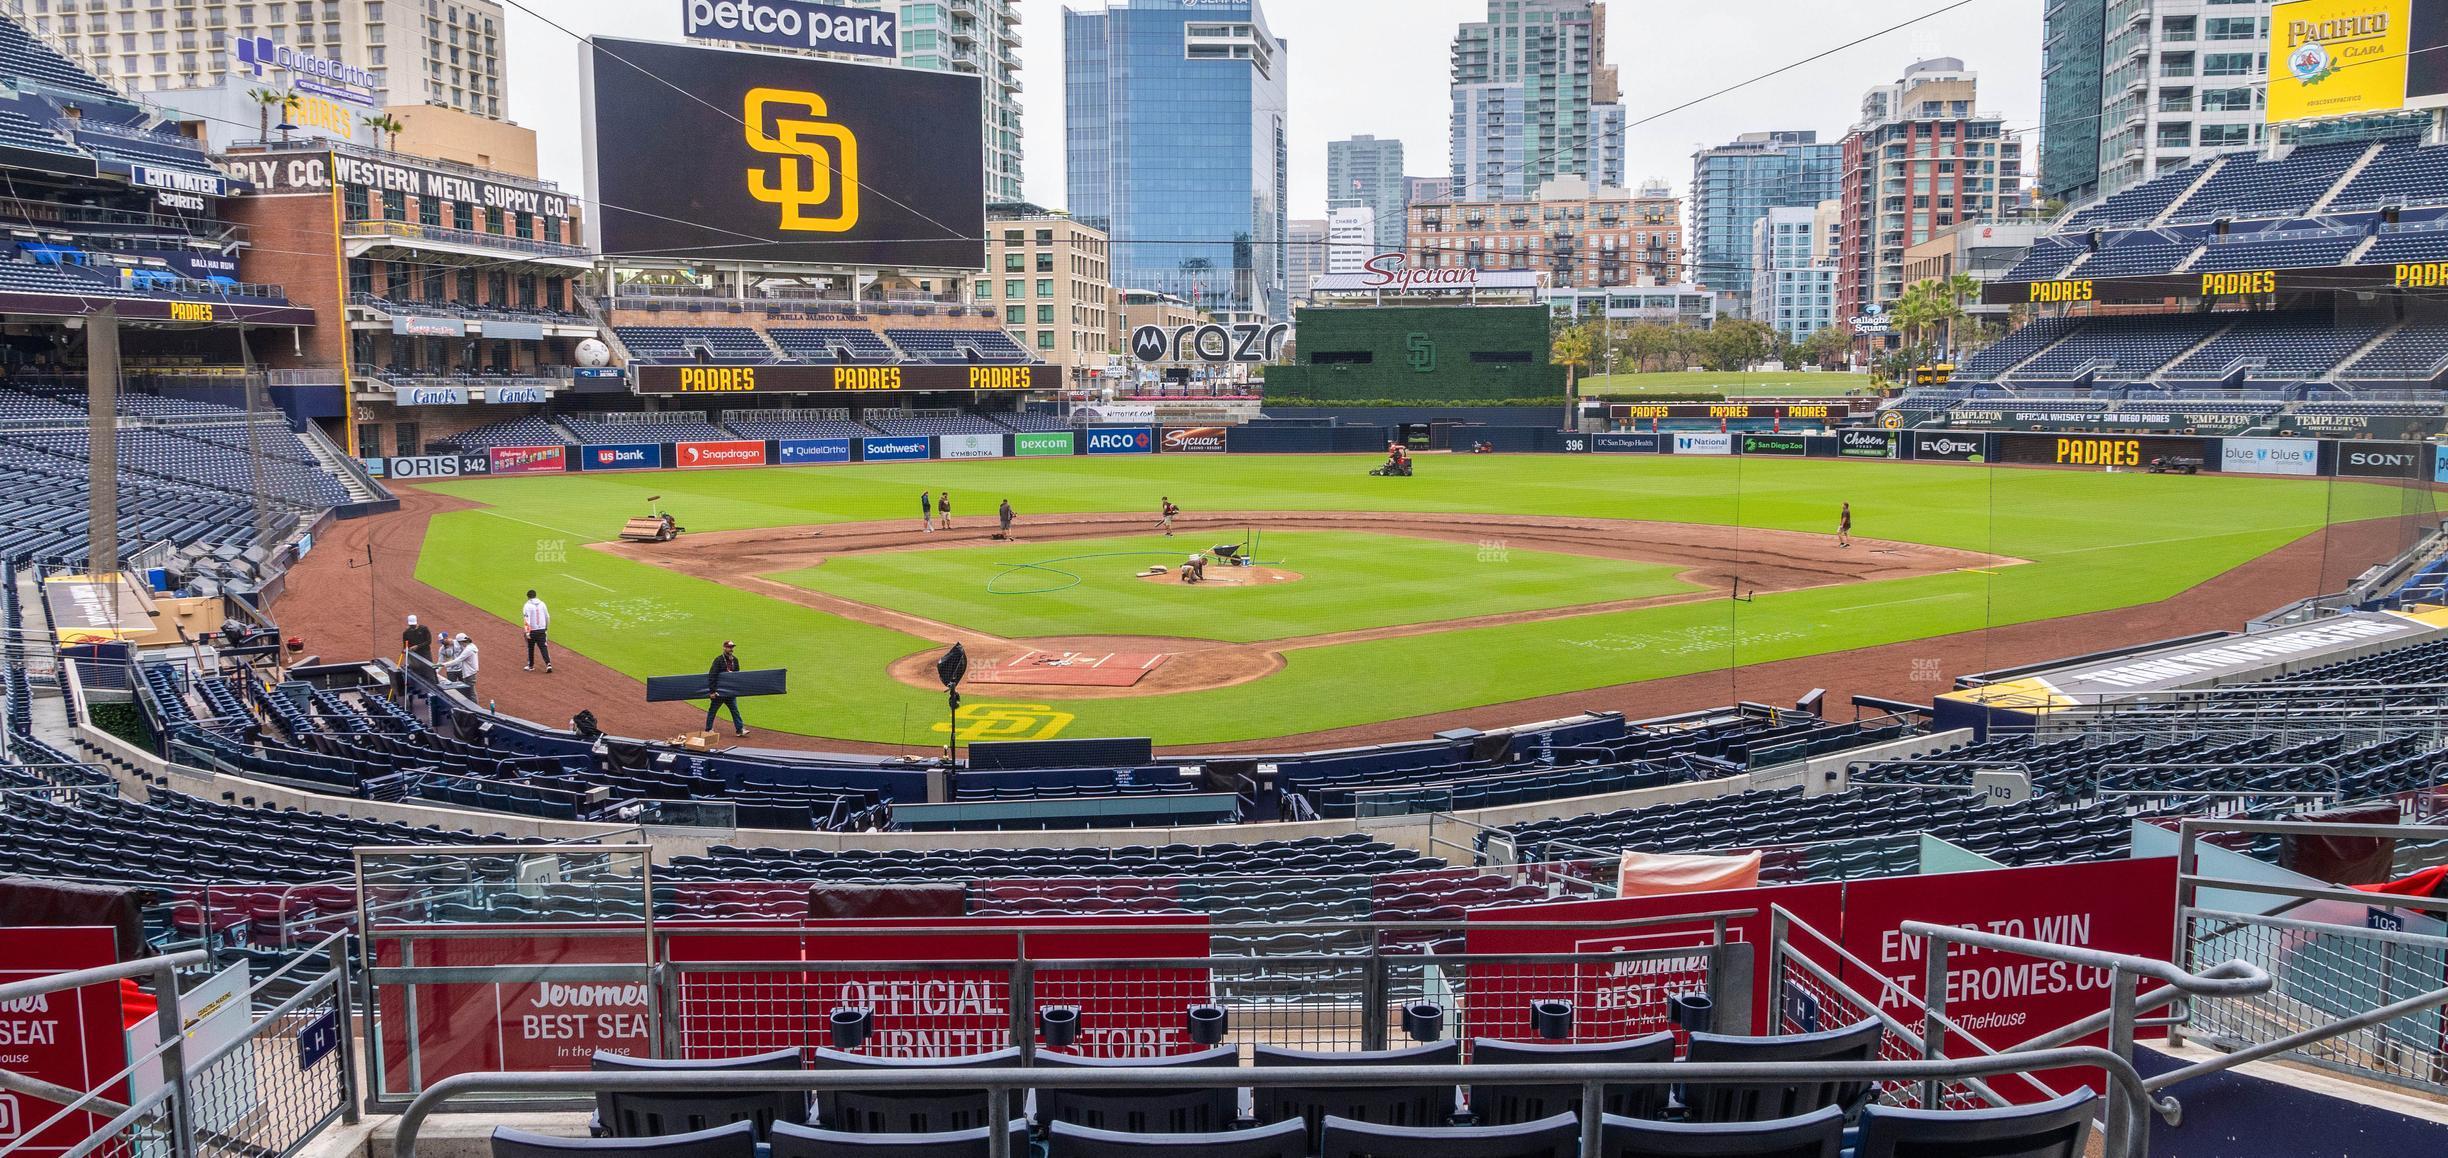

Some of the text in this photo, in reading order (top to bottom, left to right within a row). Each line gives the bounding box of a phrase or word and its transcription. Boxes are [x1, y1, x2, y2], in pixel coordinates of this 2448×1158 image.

[688, 0, 893, 47] petco park
[2288, 12, 2388, 47] PACIFICO
[2343, 44, 2385, 58] CLARA
[279, 47, 374, 88] QuidelOrtho
[744, 88, 858, 232] SD
[144, 168, 218, 194] CUTWATER
[288, 159, 331, 188] CO.
[335, 156, 568, 218] WESTERN METAL SUPPLY CO.
[159, 192, 204, 210] SPIRITS
[1362, 253, 1480, 295] Sycuan
[2395, 263, 2448, 289] PADR
[2030, 280, 2092, 302] PADRES
[2201, 271, 2275, 296] PADRES
[171, 302, 212, 321] PADRES
[1848, 316, 1893, 325] Gallaghe
[1855, 324, 1888, 333] Square
[1172, 322, 1289, 362] razr
[681, 367, 755, 392] PADRES
[834, 367, 901, 390] PADRES
[969, 366, 1031, 389] PADRES
[412, 387, 457, 405] Canel's
[498, 386, 537, 403] Canel's
[358, 407, 375, 421] 336
[1630, 406, 1668, 417] PADRES
[1710, 406, 1748, 417] PADRES
[1789, 406, 1827, 417] PADRES
[1950, 411, 2002, 421] TEMPLETON
[2016, 412, 2048, 421] OFFICIAL
[2050, 413, 2085, 422] WHISKEY
[2103, 413, 2118, 422] SAN
[2119, 414, 2140, 422] DIEGO
[2141, 414, 2170, 423] PADRES
[2184, 414, 2250, 425] TEMPLETON
[2295, 416, 2368, 427] TEMPLETON
[1089, 435, 1133, 448] ARCO
[1165, 430, 1219, 451] Sycuan
[1566, 440, 1584, 451] 396
[1619, 439, 1635, 448] Diego
[1635, 438, 1653, 447] Health
[1771, 442, 1789, 450] Diego
[1789, 442, 1803, 450] Zoo
[1844, 431, 1885, 446] Chosen
[1921, 439, 1977, 454] EVOTEK
[601, 450, 644, 461] us bank
[703, 450, 760, 460] Snapdragon
[797, 446, 847, 455] QuidelOrtho
[867, 444, 918, 454] Southwest
[2057, 439, 2140, 466] PADRES
[2225, 448, 2253, 459] blue
[2271, 448, 2300, 460] blue
[394, 457, 457, 477] ORIS
[464, 458, 486, 472] 342
[2350, 452, 2415, 466] SONY
[1988, 785, 2011, 799] 103
[2373, 915, 2397, 932] 103
[1881, 923, 1978, 963] ENER
[2033, 913, 2090, 945] WIN
[1878, 954, 2148, 1010] AT EROMES.CO.
[841, 979, 1003, 1016] OFFICIAL
[1597, 983, 1656, 1011] BEST
[1797, 998, 1805, 1020] H
[0, 1020, 58, 1045] SEAT
[523, 1014, 649, 1039] BEST SEA
[314, 1032, 325, 1051] H
[558, 1046, 570, 1057] In
[572, 1046, 592, 1057] the
